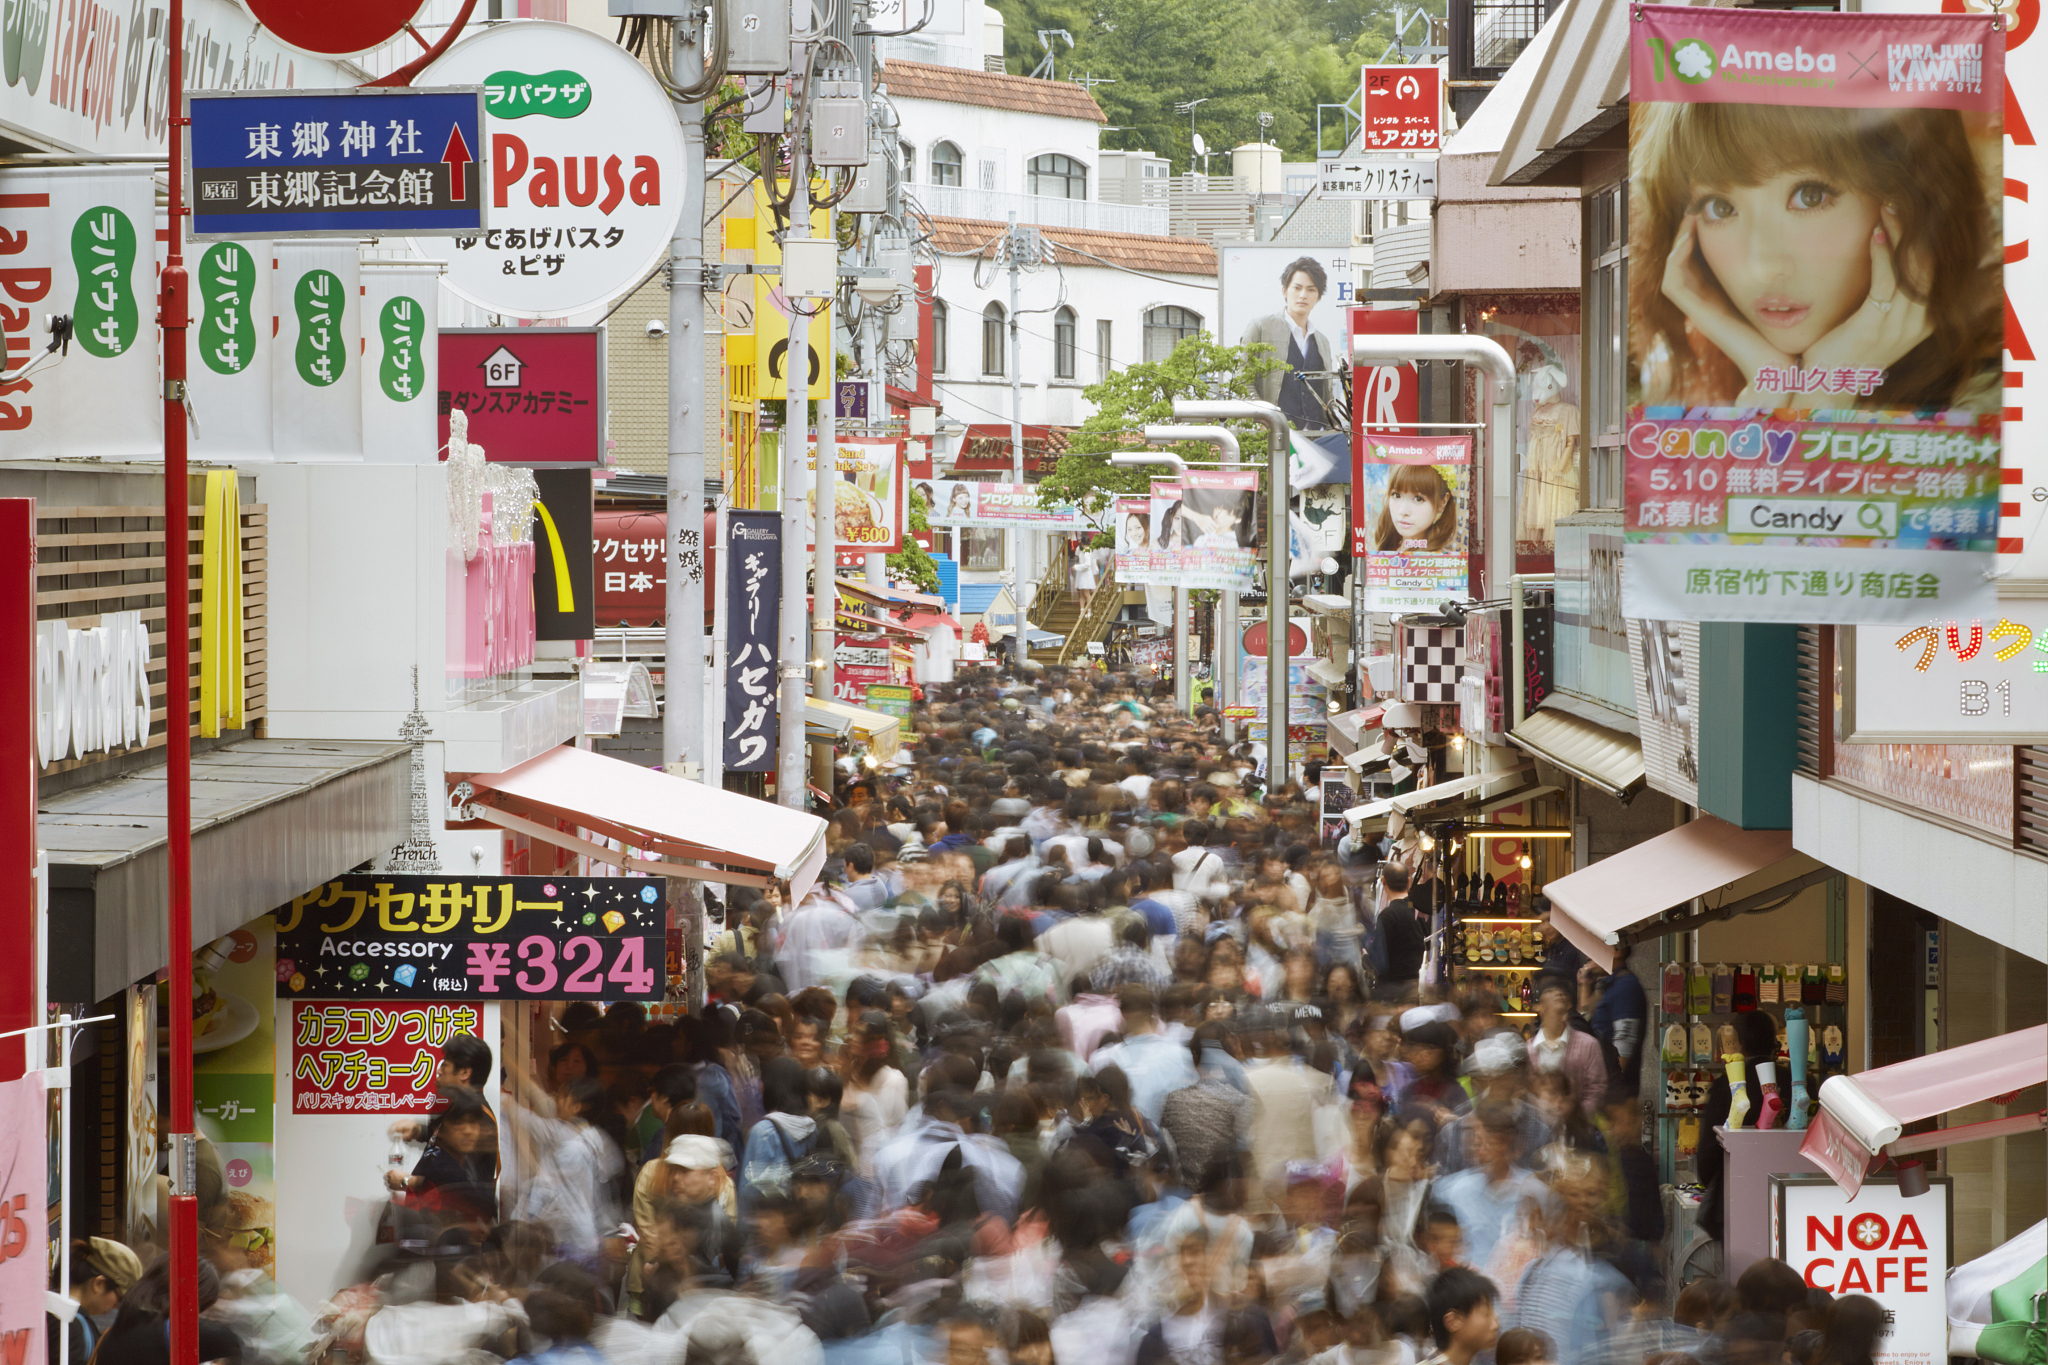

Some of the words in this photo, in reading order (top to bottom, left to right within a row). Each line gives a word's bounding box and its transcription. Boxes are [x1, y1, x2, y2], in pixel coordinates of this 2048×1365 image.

[744, 17, 758, 30] 灯
[1720, 44, 1836, 73] Ameba
[1887, 43, 1983, 61] HARAJUKU
[484, 82, 587, 105] ラパウザ
[1369, 75, 1390, 87] 2F
[1739, 71, 1836, 91] Anniversary
[1888, 82, 1938, 92] WEEK
[1946, 82, 1982, 95] 2014
[1373, 116, 1399, 125] レンタル
[1404, 116, 1430, 125] スペース
[245, 119, 424, 160] 東郷神社
[1381, 129, 1438, 147] アガサ
[492, 133, 661, 216] Pausa
[1322, 181, 1362, 192] 紅茶専門店
[1363, 168, 1434, 194] クリスティー
[1324, 163, 1341, 174] 1F
[203, 181, 237, 199] 原宿
[246, 167, 434, 209] 東郷記念館
[502, 253, 566, 277] &ピザ
[89, 212, 122, 353] ラパウザ
[215, 247, 241, 371] ラパウザ
[308, 274, 333, 383] ラパウザ
[392, 300, 413, 399] ラパウザ
[489, 362, 516, 381] 6F
[1755, 366, 1885, 396] 舟山久美子
[838, 447, 866, 459] Sand
[1388, 445, 1423, 455] Ameba
[1626, 422, 1795, 467] Candy
[855, 462, 874, 472] Set
[1650, 468, 1719, 491] 5.10
[760, 485, 777, 495] AR
[1638, 501, 1719, 528] 応募は
[1750, 504, 1844, 533] Candy
[845, 526, 890, 543] ¥500
[1366, 556, 1409, 568] Candy
[744, 551, 768, 635] ギャラリー
[1395, 578, 1423, 587] Candy
[1685, 567, 1941, 599] 原宿竹下通り商店会
[729, 642, 775, 768] ハセガワ
[1960, 678, 2011, 718] B1
[417, 727, 434, 737] Tower
[391, 844, 438, 862] French
[276, 881, 563, 934] アクセサリー
[319, 935, 454, 961] Accessory
[432, 977, 469, 993] (税込)
[465, 934, 655, 994] ¥324
[297, 1004, 400, 1047] カラコン
[401, 1004, 478, 1047] つけま
[296, 1049, 435, 1092] ヘアチョーク
[194, 1099, 256, 1122] ーガー
[296, 1092, 450, 1111] パリスキッズ奥エレベーター
[228, 1165, 248, 1179] えび
[1806, 1212, 1929, 1252] NOA
[1803, 1256, 1929, 1294] CAFE
